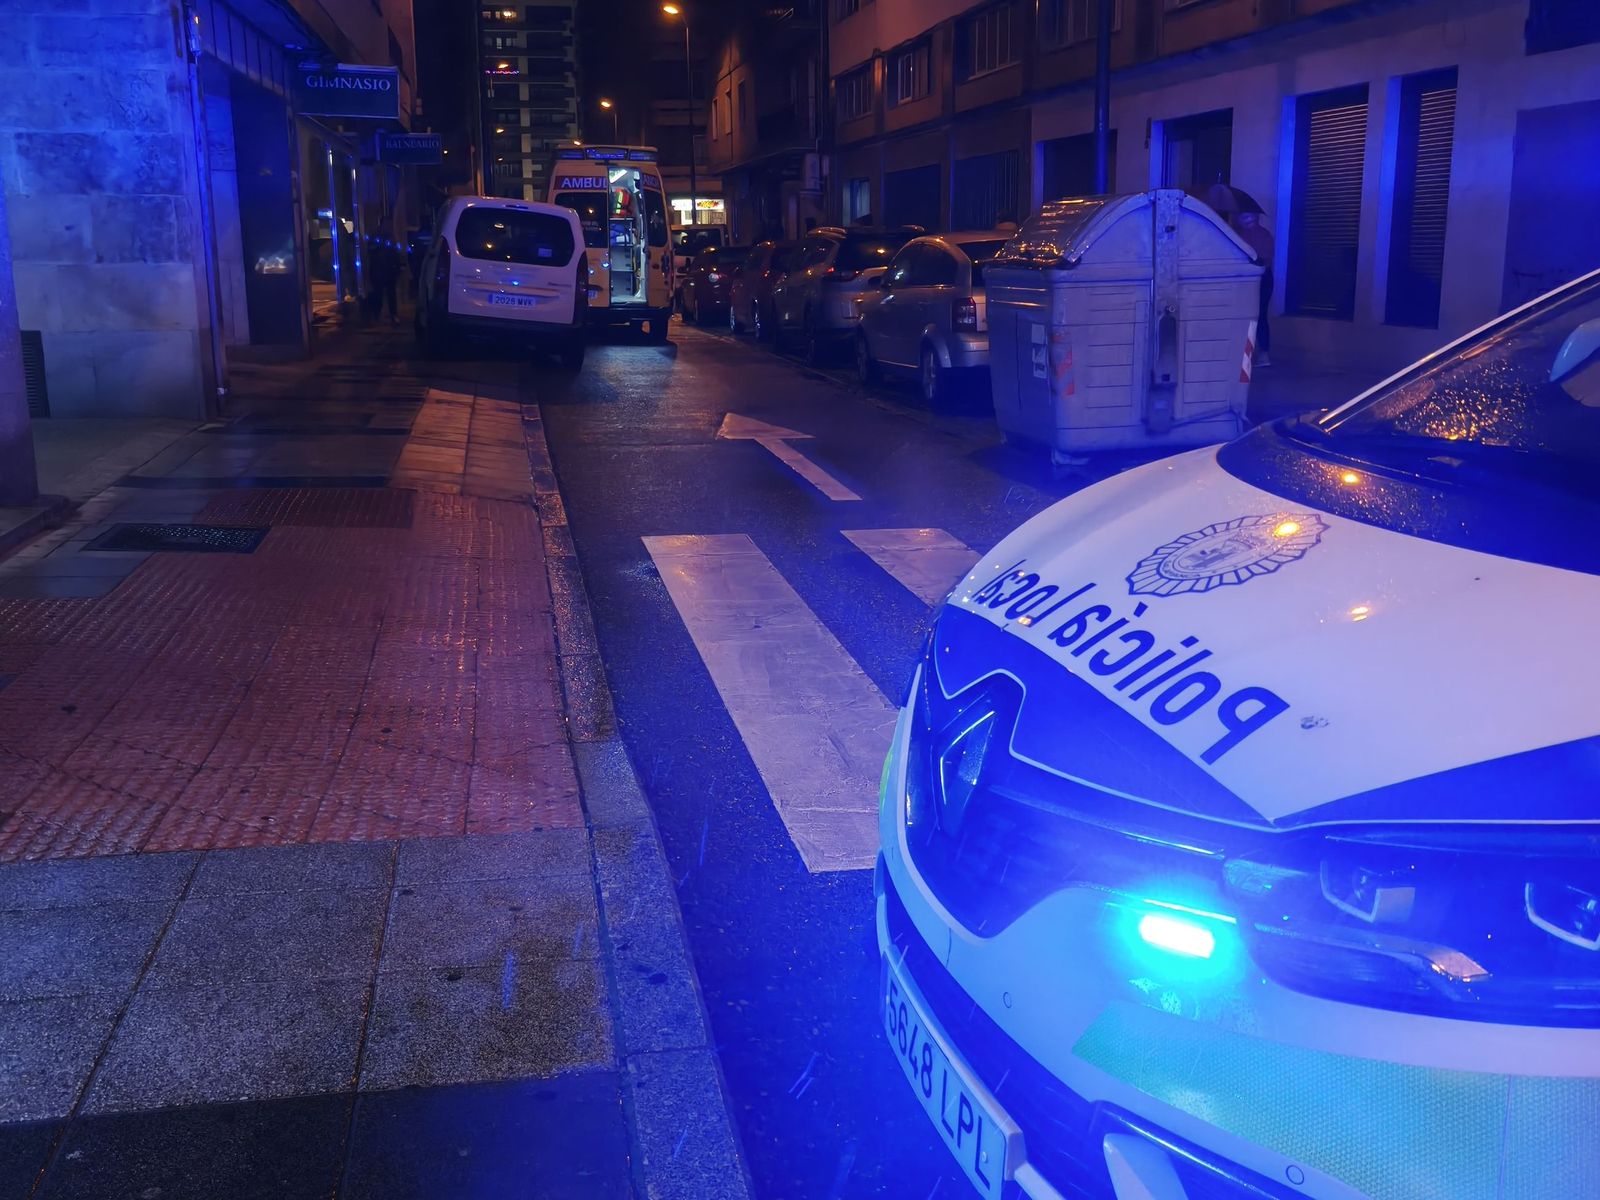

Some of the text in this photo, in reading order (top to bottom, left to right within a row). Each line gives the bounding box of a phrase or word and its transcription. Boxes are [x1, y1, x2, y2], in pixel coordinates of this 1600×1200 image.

[306, 75, 391, 92] GIMNASIO
[561, 177, 608, 188] AMBUL
[889, 980, 990, 1191] 5648 LPL
